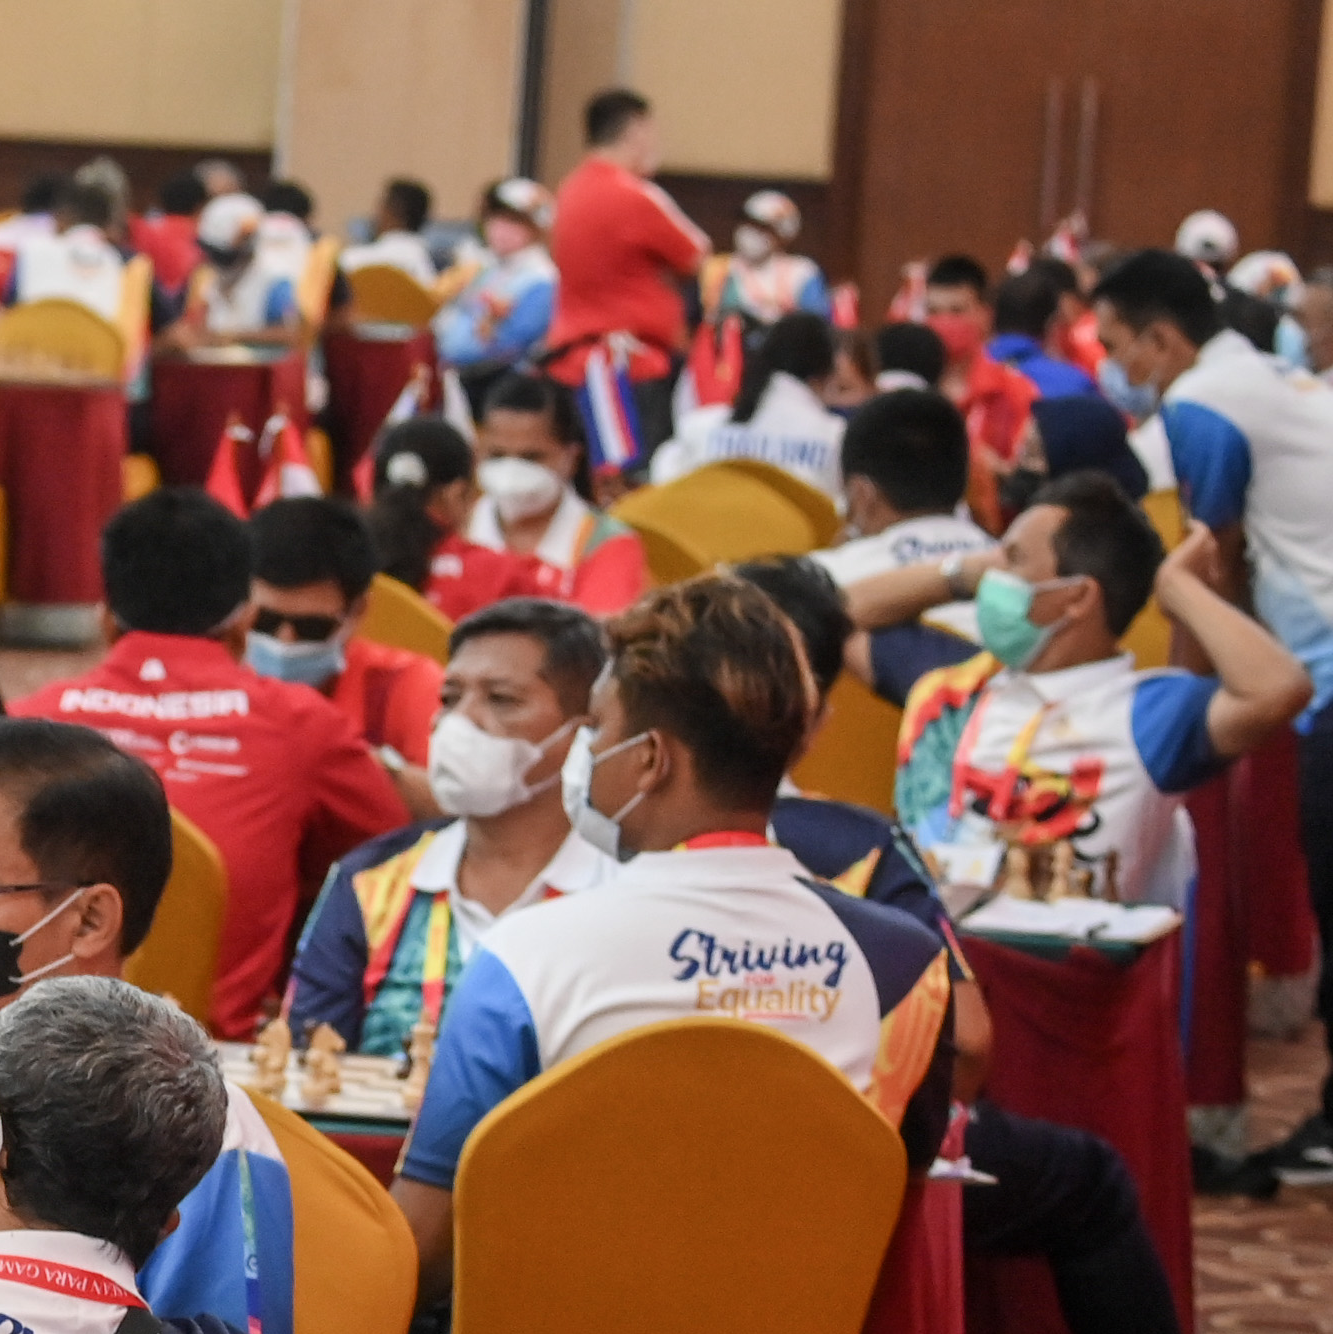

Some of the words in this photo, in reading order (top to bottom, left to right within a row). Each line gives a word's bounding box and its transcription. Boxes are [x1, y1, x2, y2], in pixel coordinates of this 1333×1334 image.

[669, 927, 848, 989] Striving
[695, 979, 844, 1024] Equality
[44, 1267, 89, 1291] PARA
